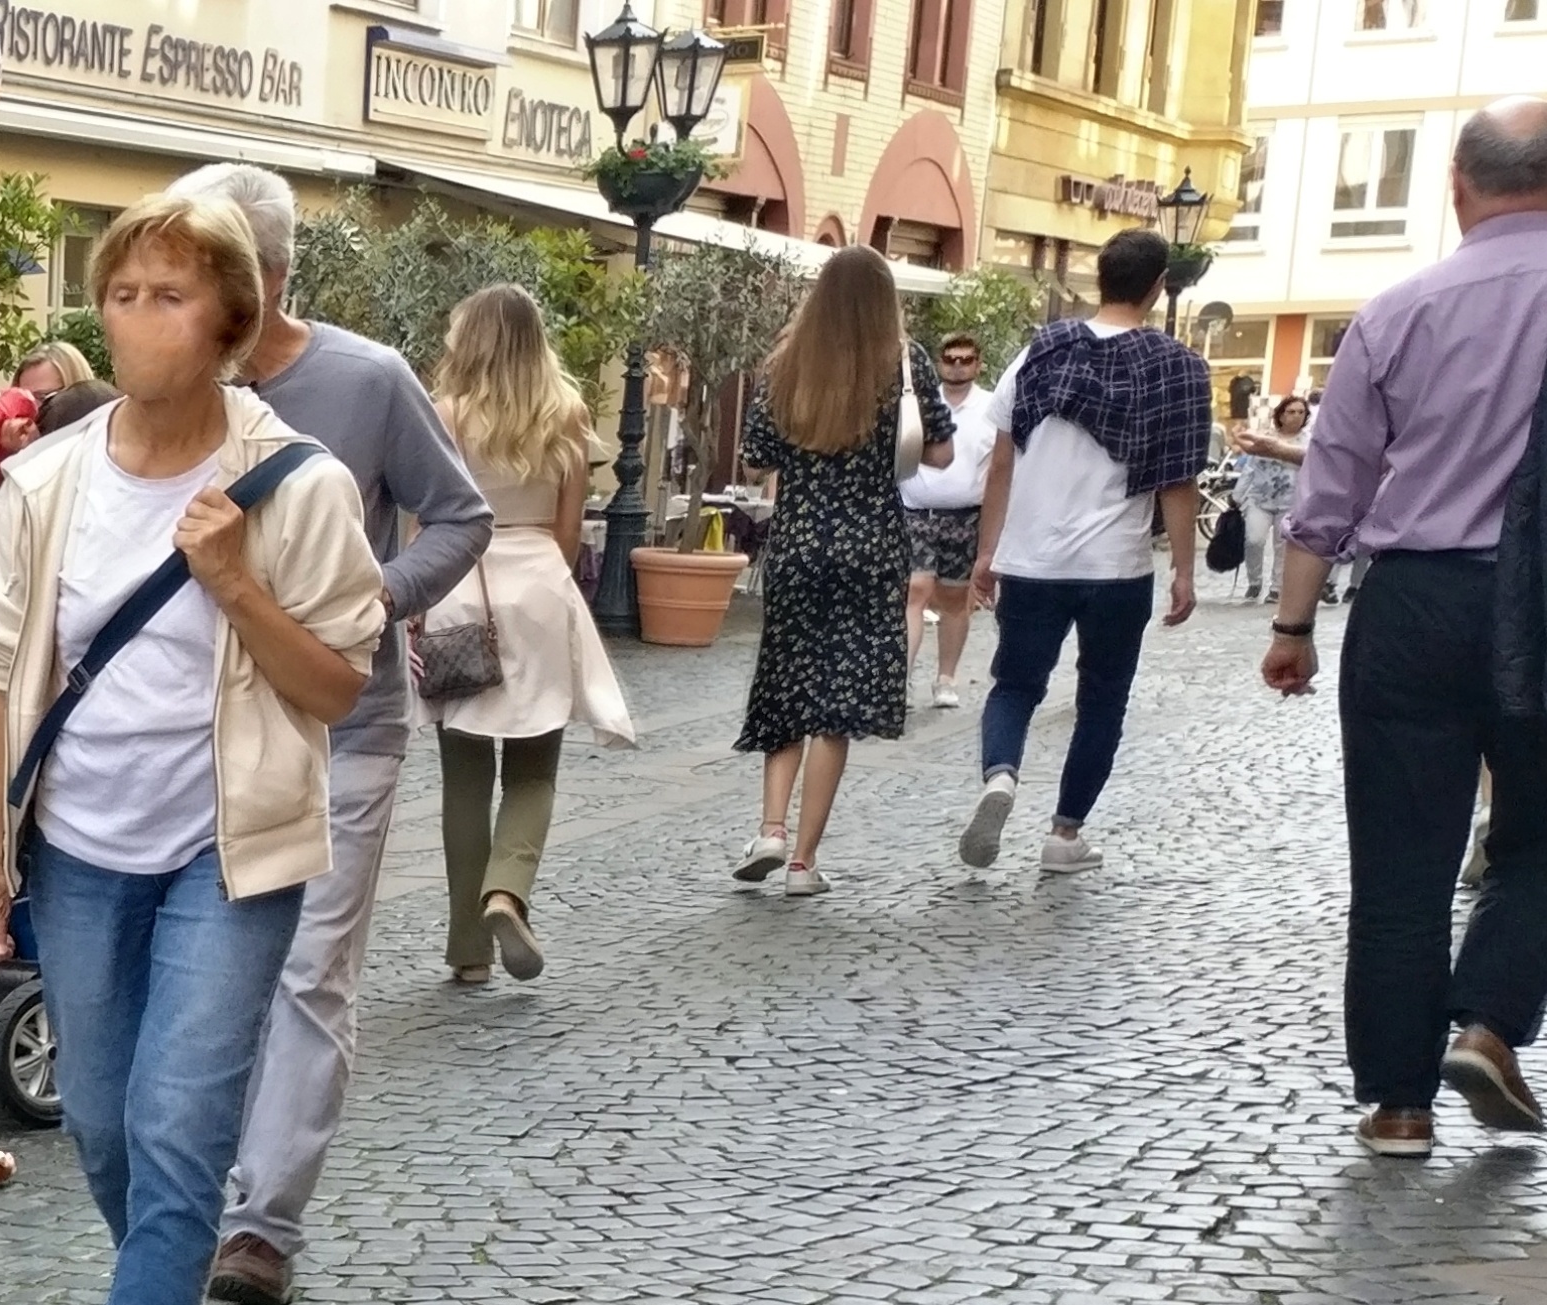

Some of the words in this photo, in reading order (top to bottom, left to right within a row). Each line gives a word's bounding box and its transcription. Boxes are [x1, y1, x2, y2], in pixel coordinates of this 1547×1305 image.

[140, 23, 254, 100] ESPRESSO
[258, 47, 303, 107] BAR
[502, 86, 593, 159] ENOTECA
